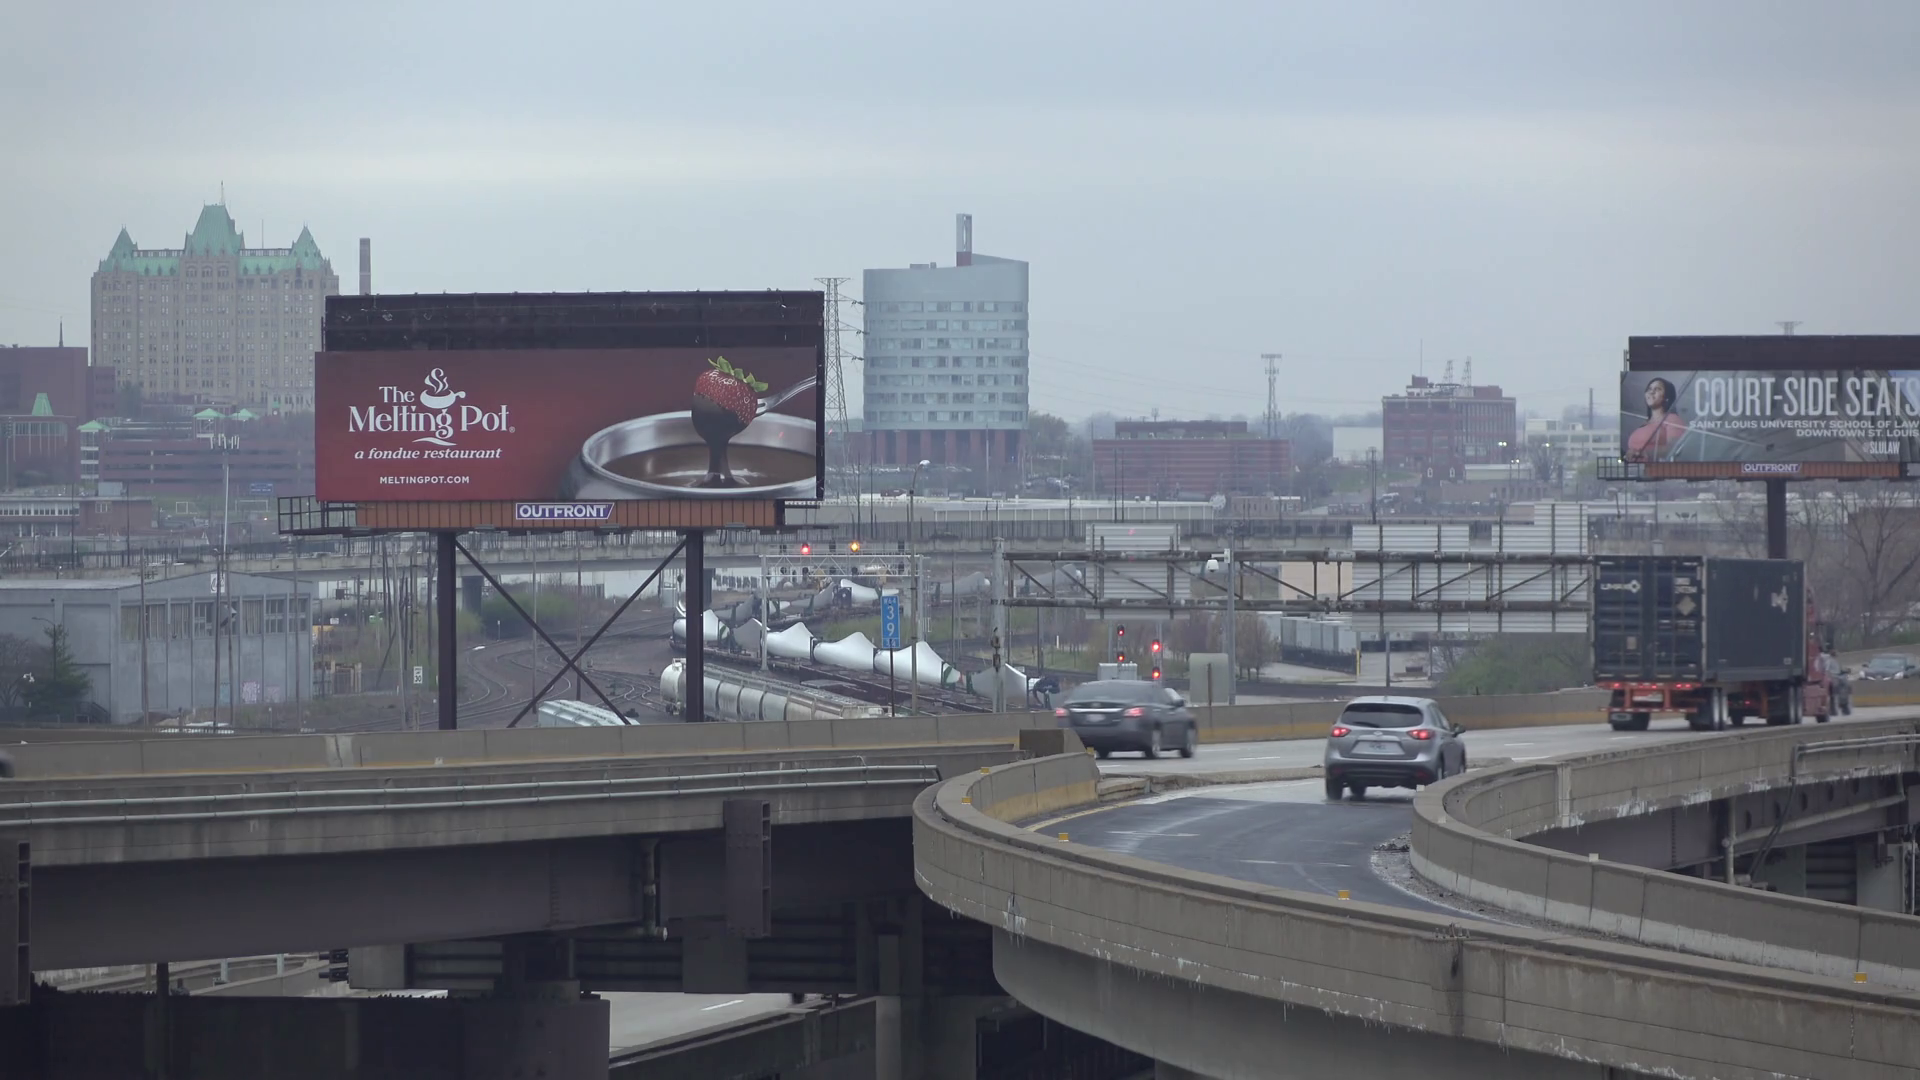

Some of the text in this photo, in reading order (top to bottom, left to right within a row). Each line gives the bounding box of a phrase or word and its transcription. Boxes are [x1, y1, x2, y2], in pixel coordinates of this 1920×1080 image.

[379, 386, 415, 403] The
[1694, 377, 1920, 416] COURT-SIDE SEATS
[348, 404, 509, 439] Melting Pot
[1689, 420, 1920, 429] SAINT LOUIS UNIVERSITY SCHOOL OF LAW
[1796, 429, 1919, 437] DOWNTOWN ST. LOUIS
[354, 448, 503, 459] a fondue restaurant
[1743, 463, 1799, 472] OUTFRONT
[379, 476, 470, 485] MELTINGPOT.COM
[519, 504, 607, 518] OUTFRONT
